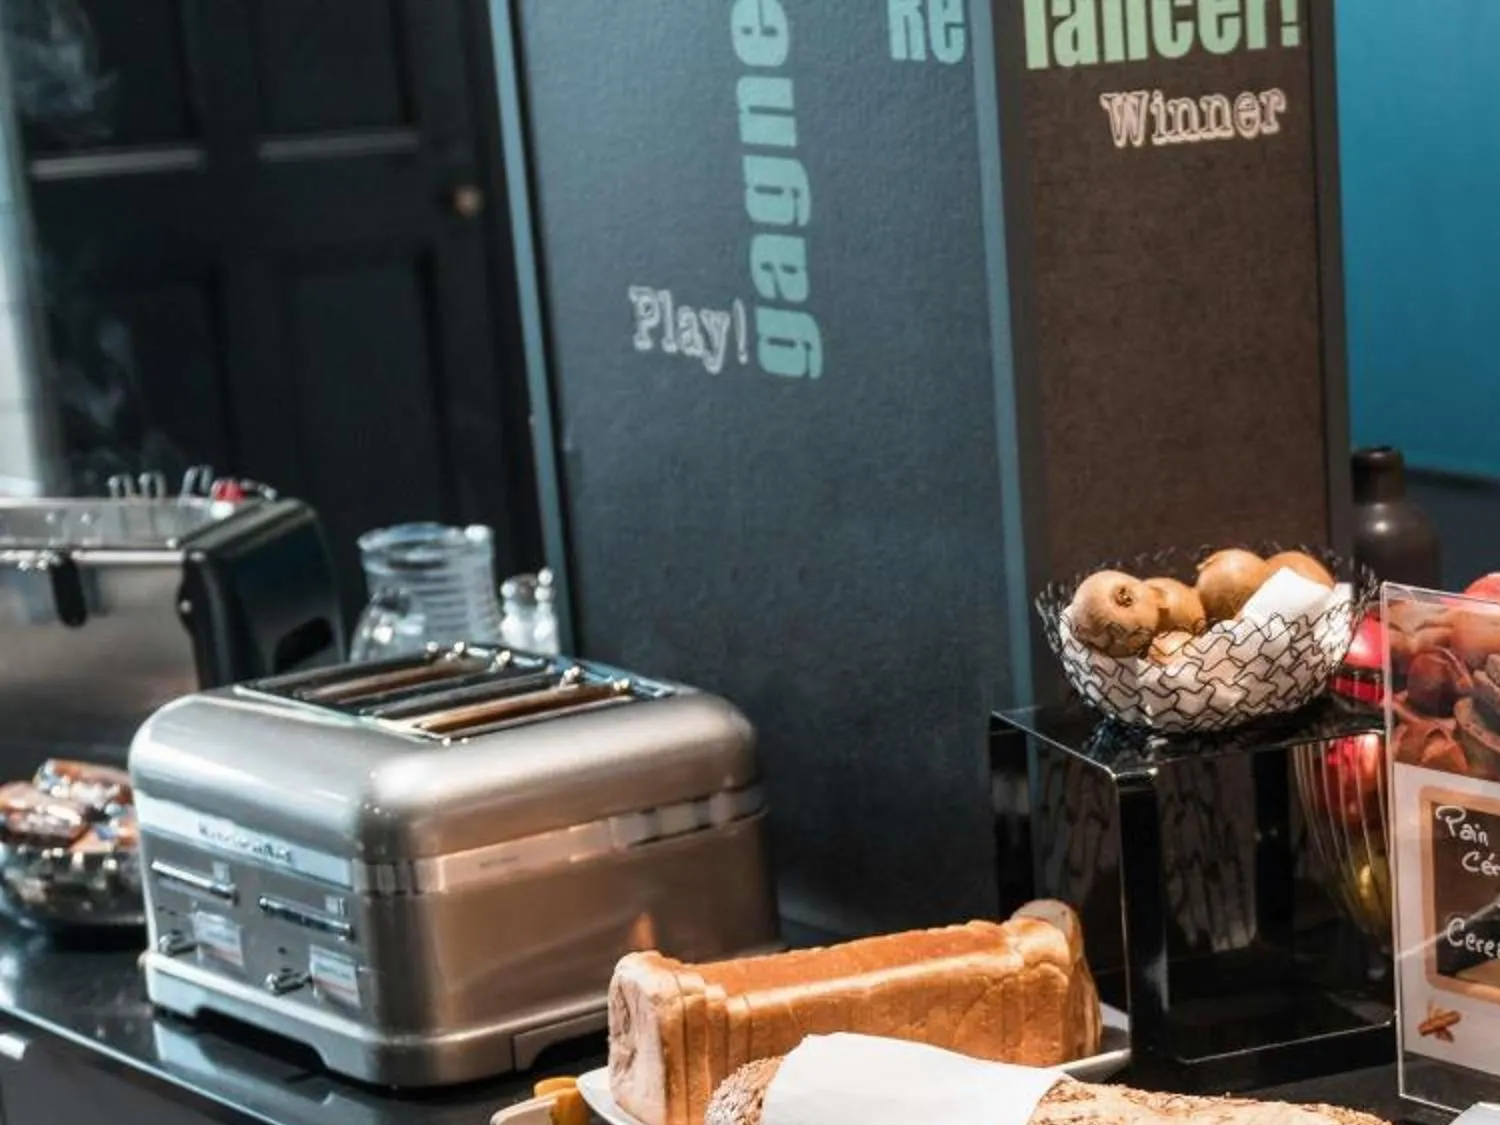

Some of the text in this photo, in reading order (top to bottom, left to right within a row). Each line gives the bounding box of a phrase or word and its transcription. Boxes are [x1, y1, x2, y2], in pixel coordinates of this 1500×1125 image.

[1100, 87, 1286, 149] Winner
[628, 285, 748, 375] Play!
[1435, 805, 1489, 847] Pain
